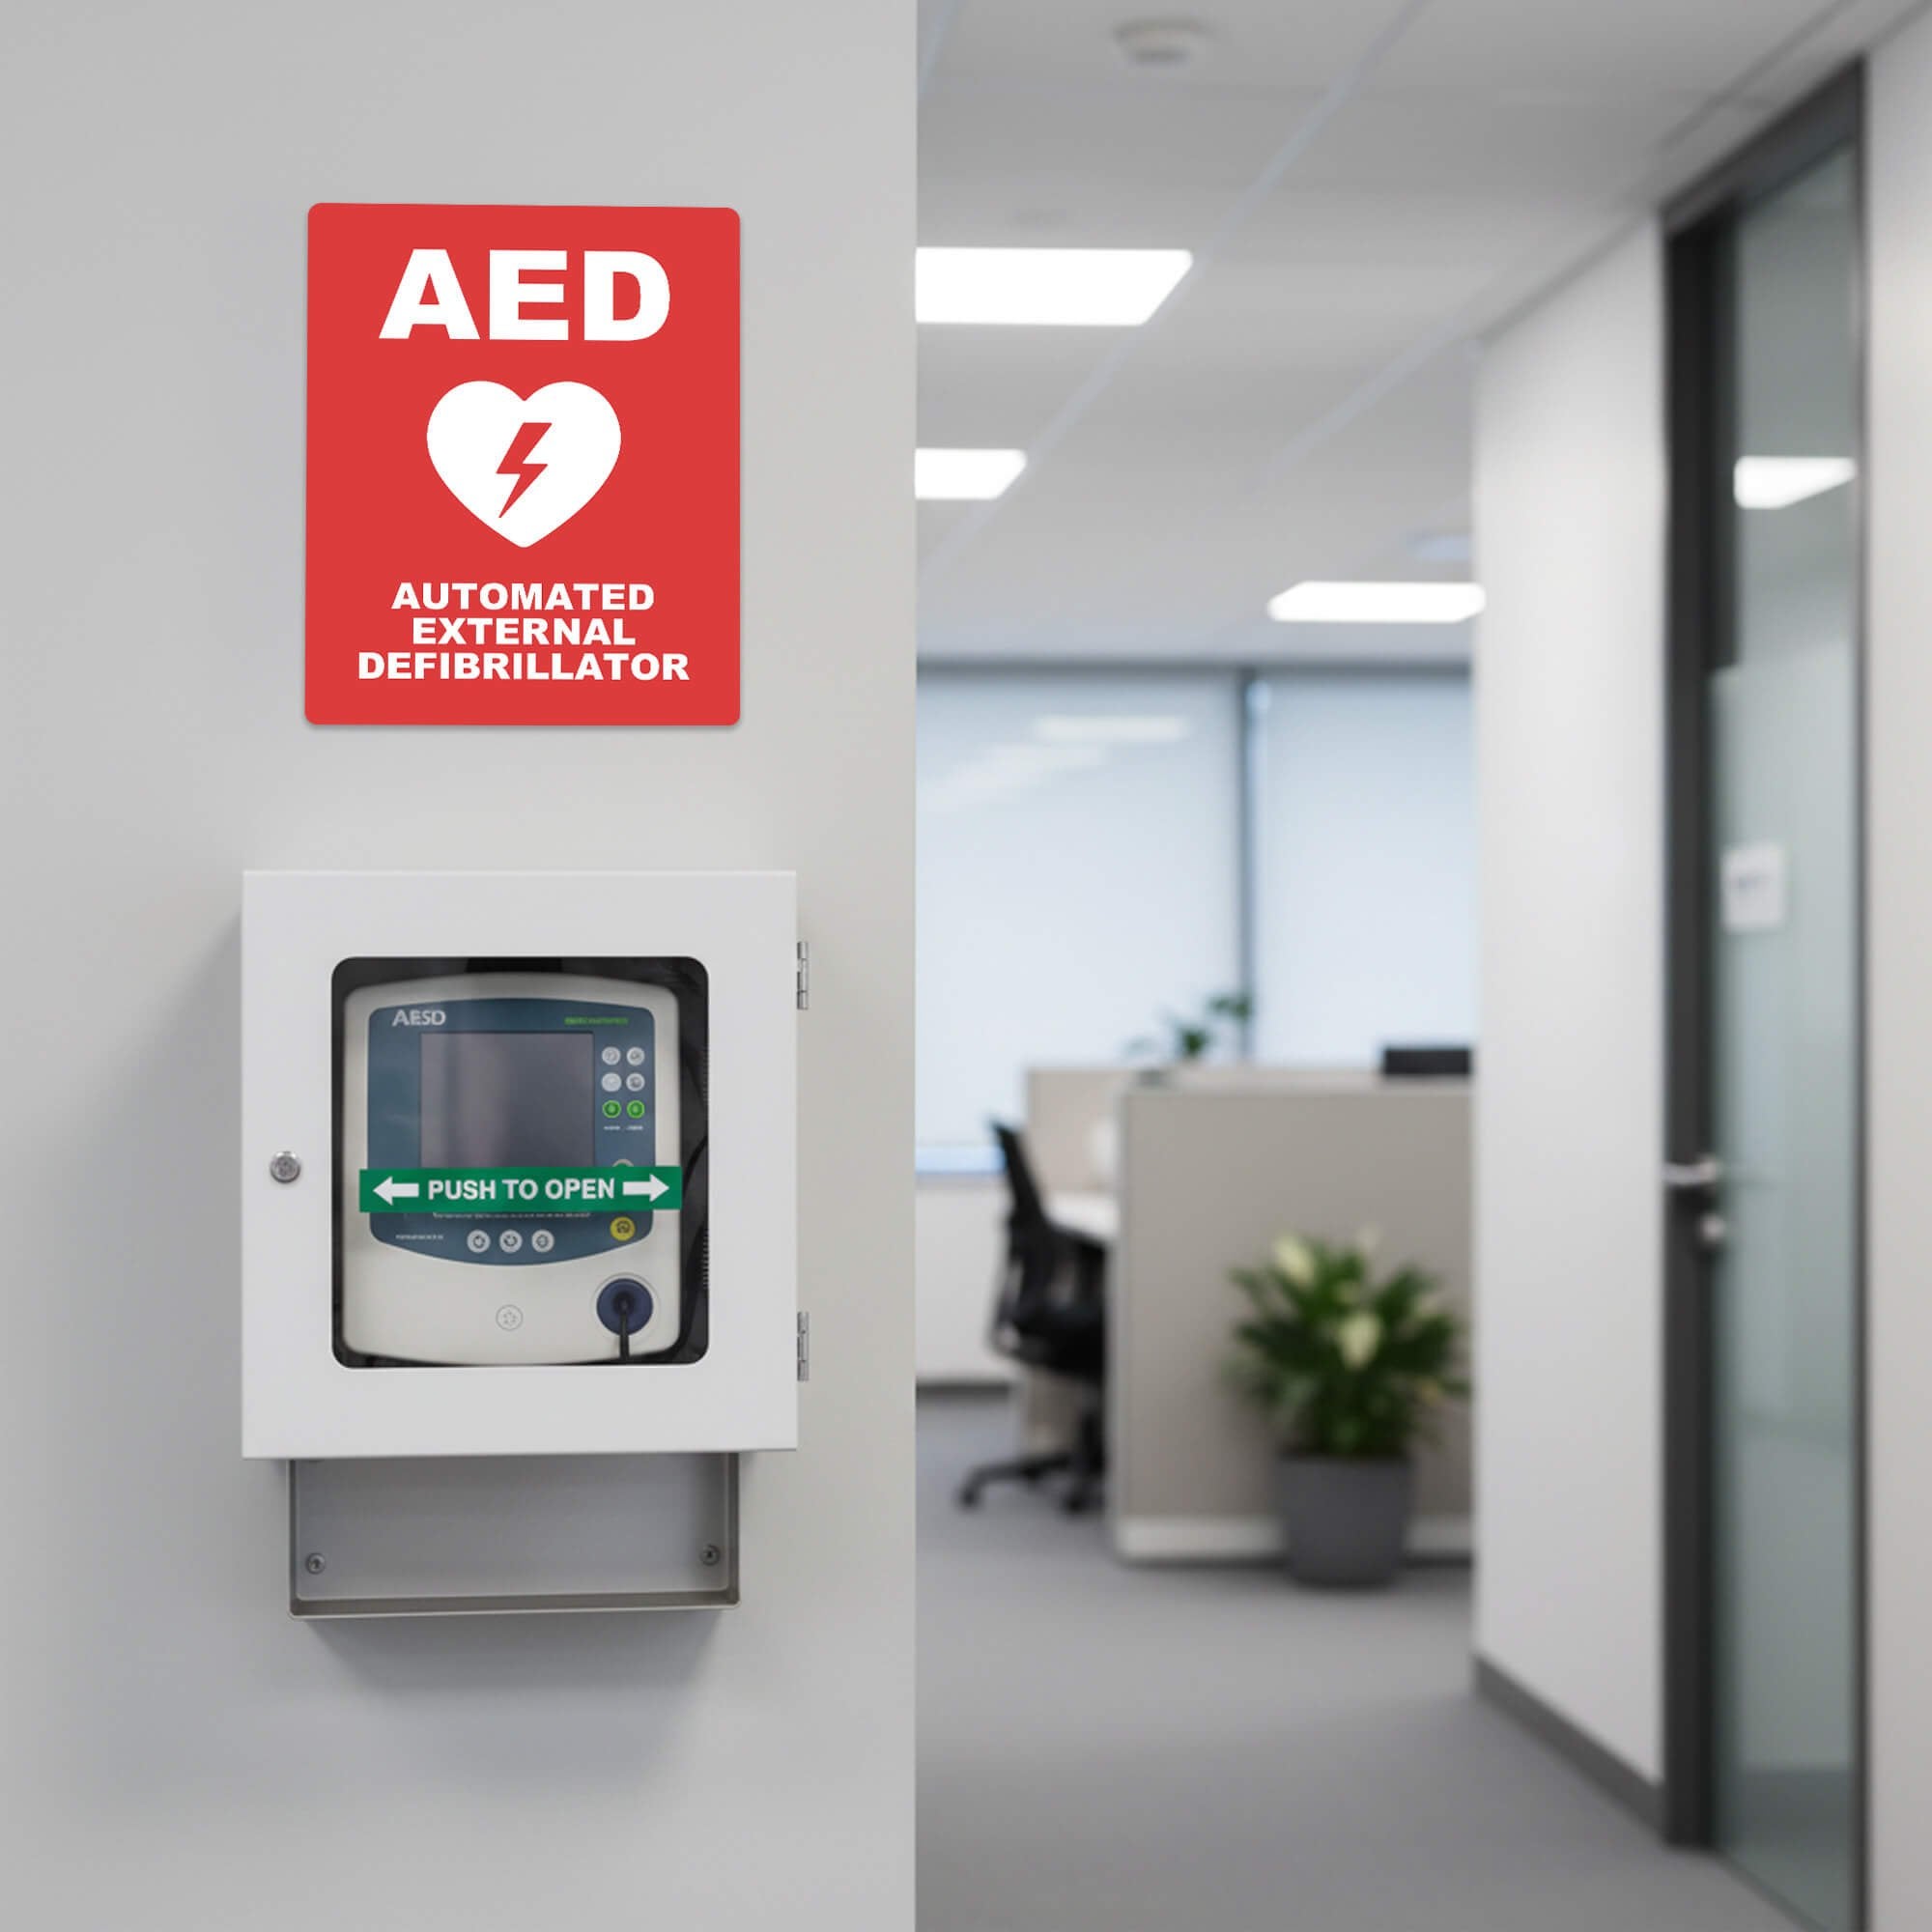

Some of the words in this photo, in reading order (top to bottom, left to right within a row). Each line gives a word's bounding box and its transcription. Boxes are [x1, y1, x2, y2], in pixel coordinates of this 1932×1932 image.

[379, 249, 669, 341] AED
[391, 582, 654, 610] AUTOMATED
[413, 618, 636, 644] EXTERNAL
[359, 652, 689, 680] DEFIBRILLATOR
[392, 1009, 446, 1026] AESD
[429, 1180, 495, 1200] PUSH
[502, 1179, 538, 1199] TO
[546, 1179, 613, 1199] OPEN
